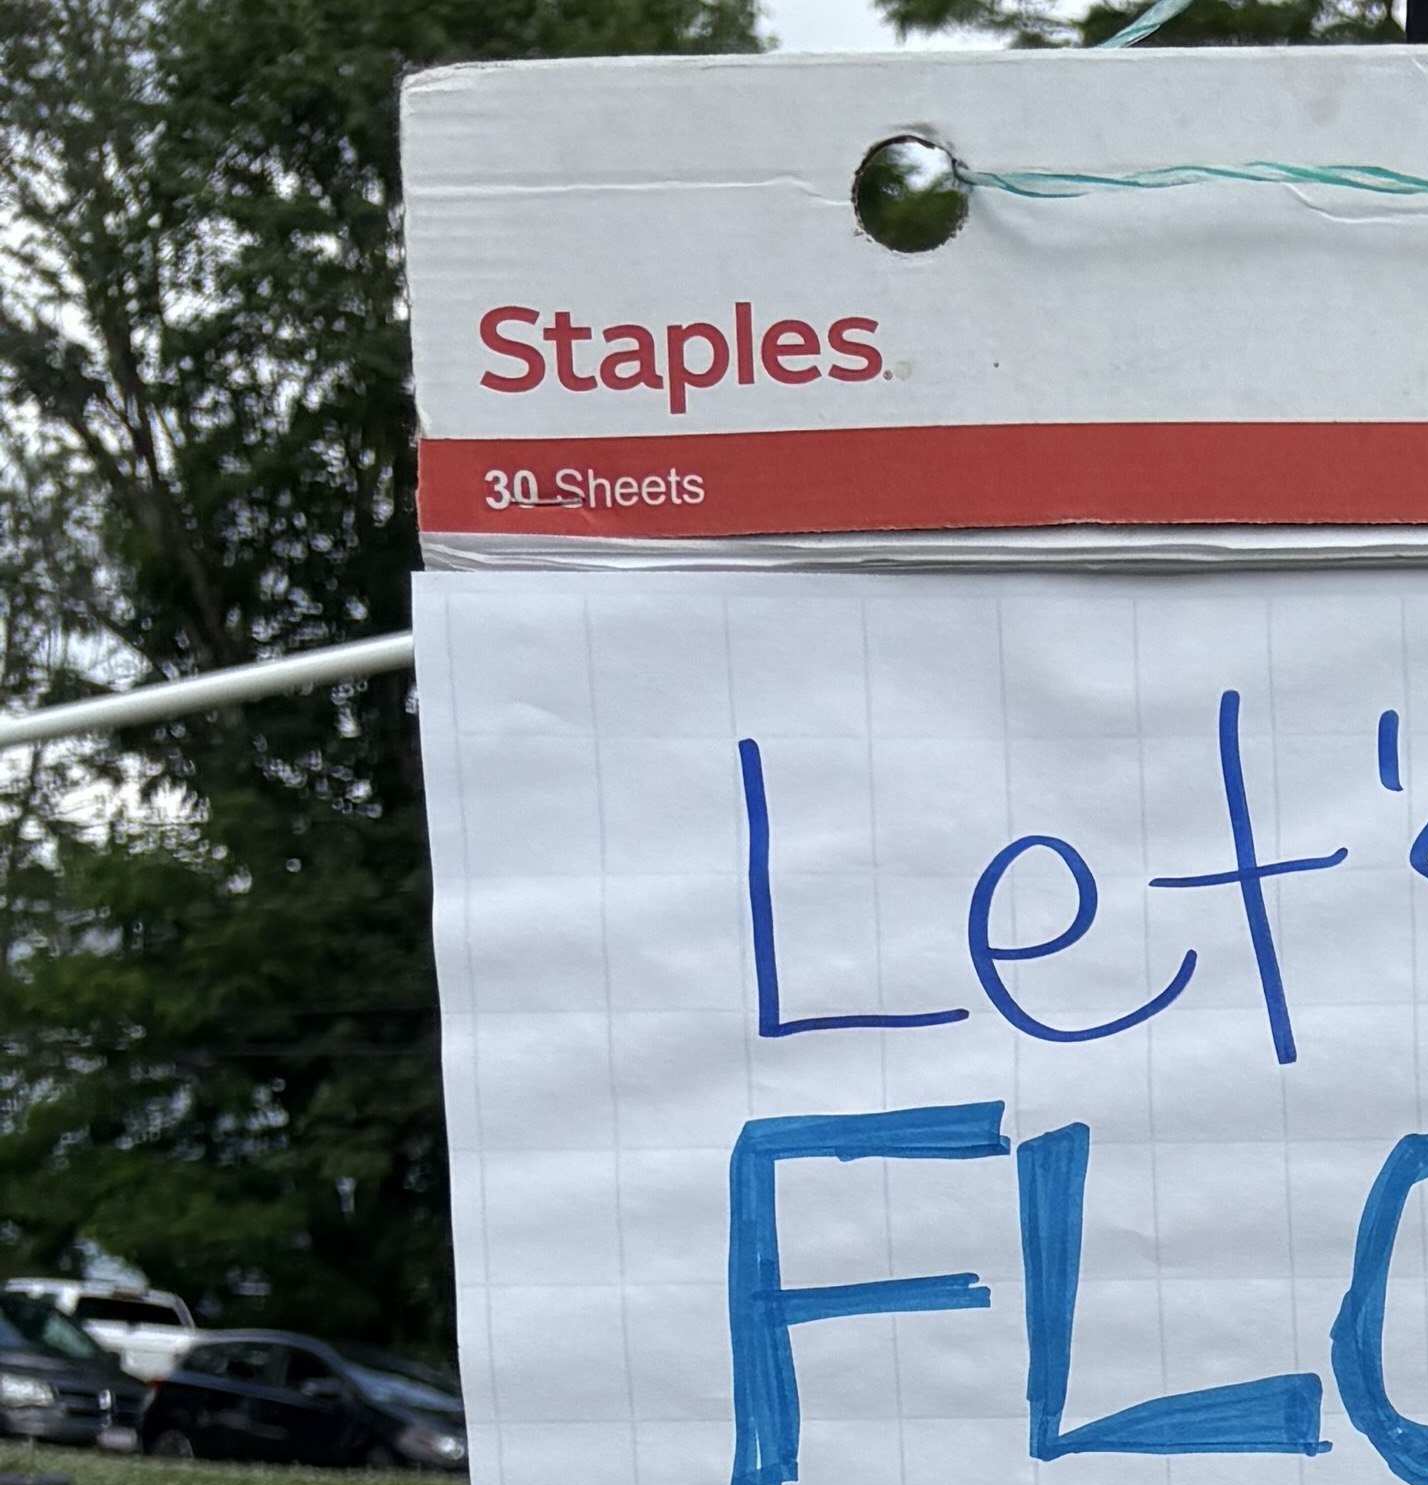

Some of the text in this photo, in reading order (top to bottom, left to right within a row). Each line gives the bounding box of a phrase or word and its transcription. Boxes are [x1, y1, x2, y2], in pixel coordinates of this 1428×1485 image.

[479, 302, 884, 415] Staples
[483, 467, 706, 510] 30 Sheets
